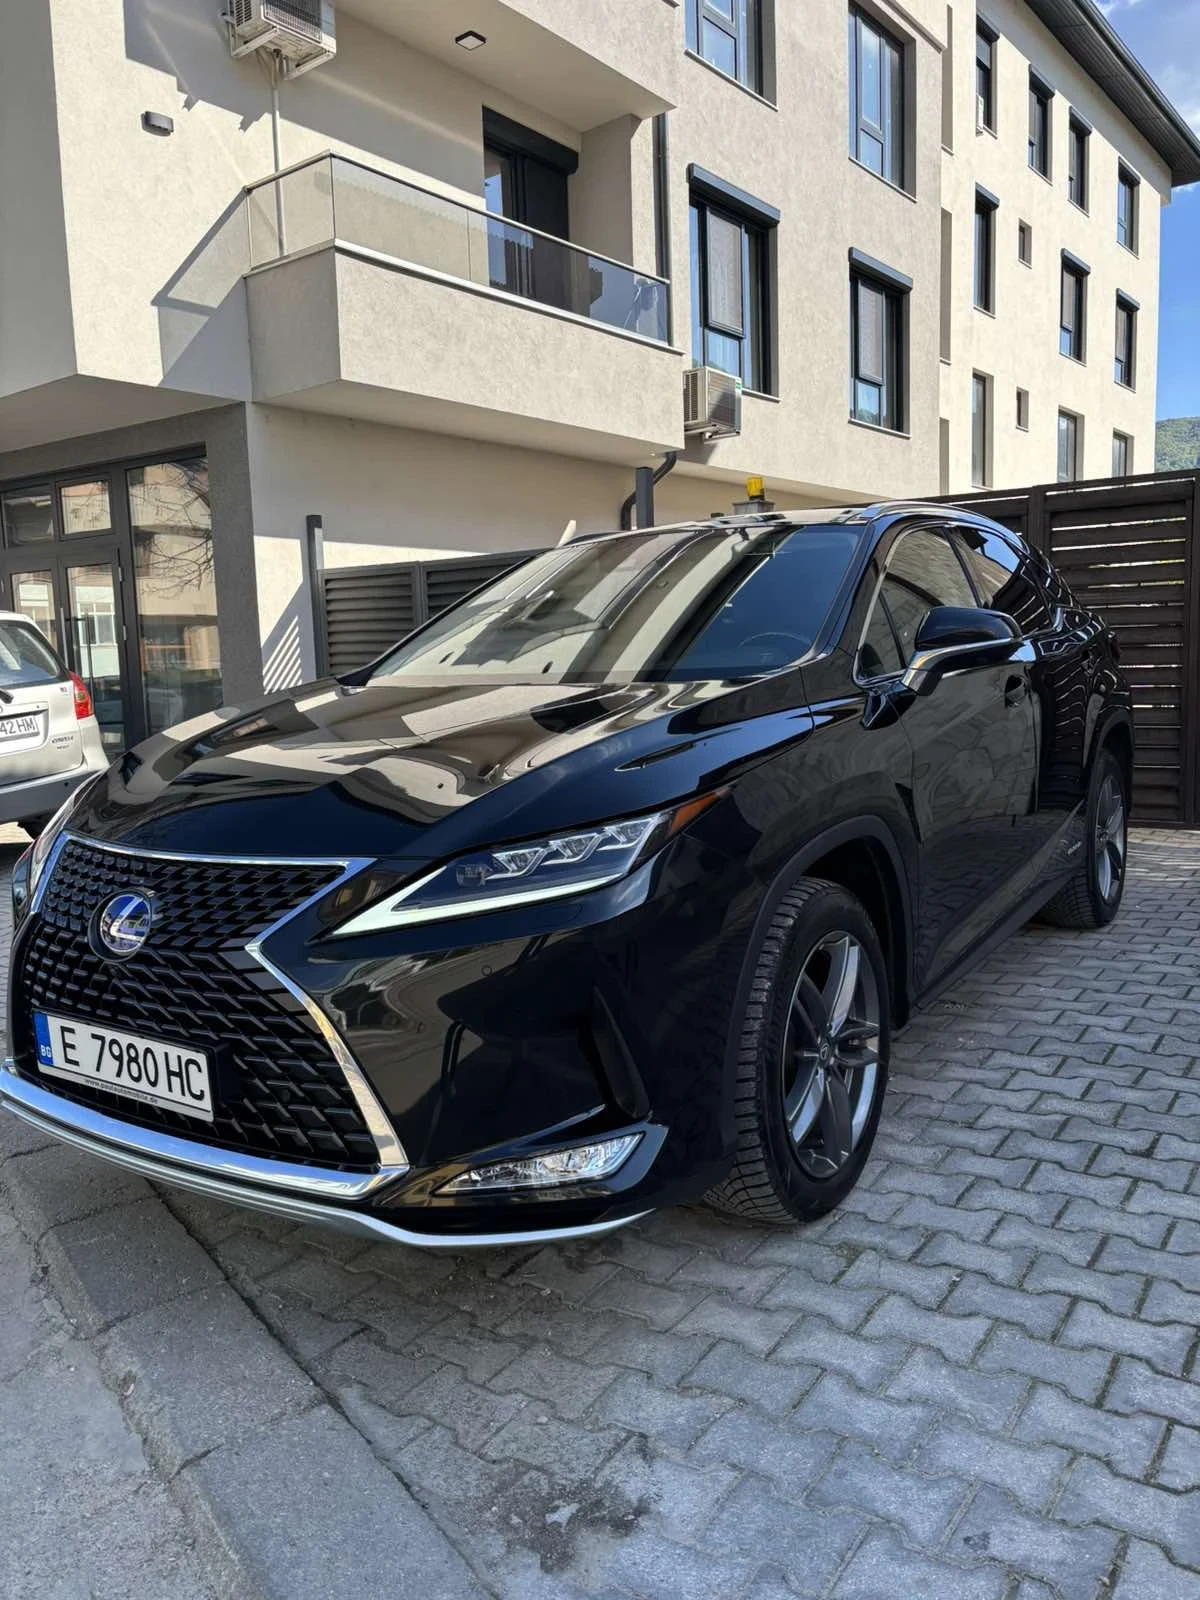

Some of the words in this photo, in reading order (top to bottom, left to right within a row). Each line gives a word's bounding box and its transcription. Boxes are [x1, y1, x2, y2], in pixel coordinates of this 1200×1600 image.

[40, 1044, 52, 1058] BG
[60, 1025, 80, 1067] E
[91, 1033, 159, 1088] 7980
[164, 1051, 205, 1101] HC
